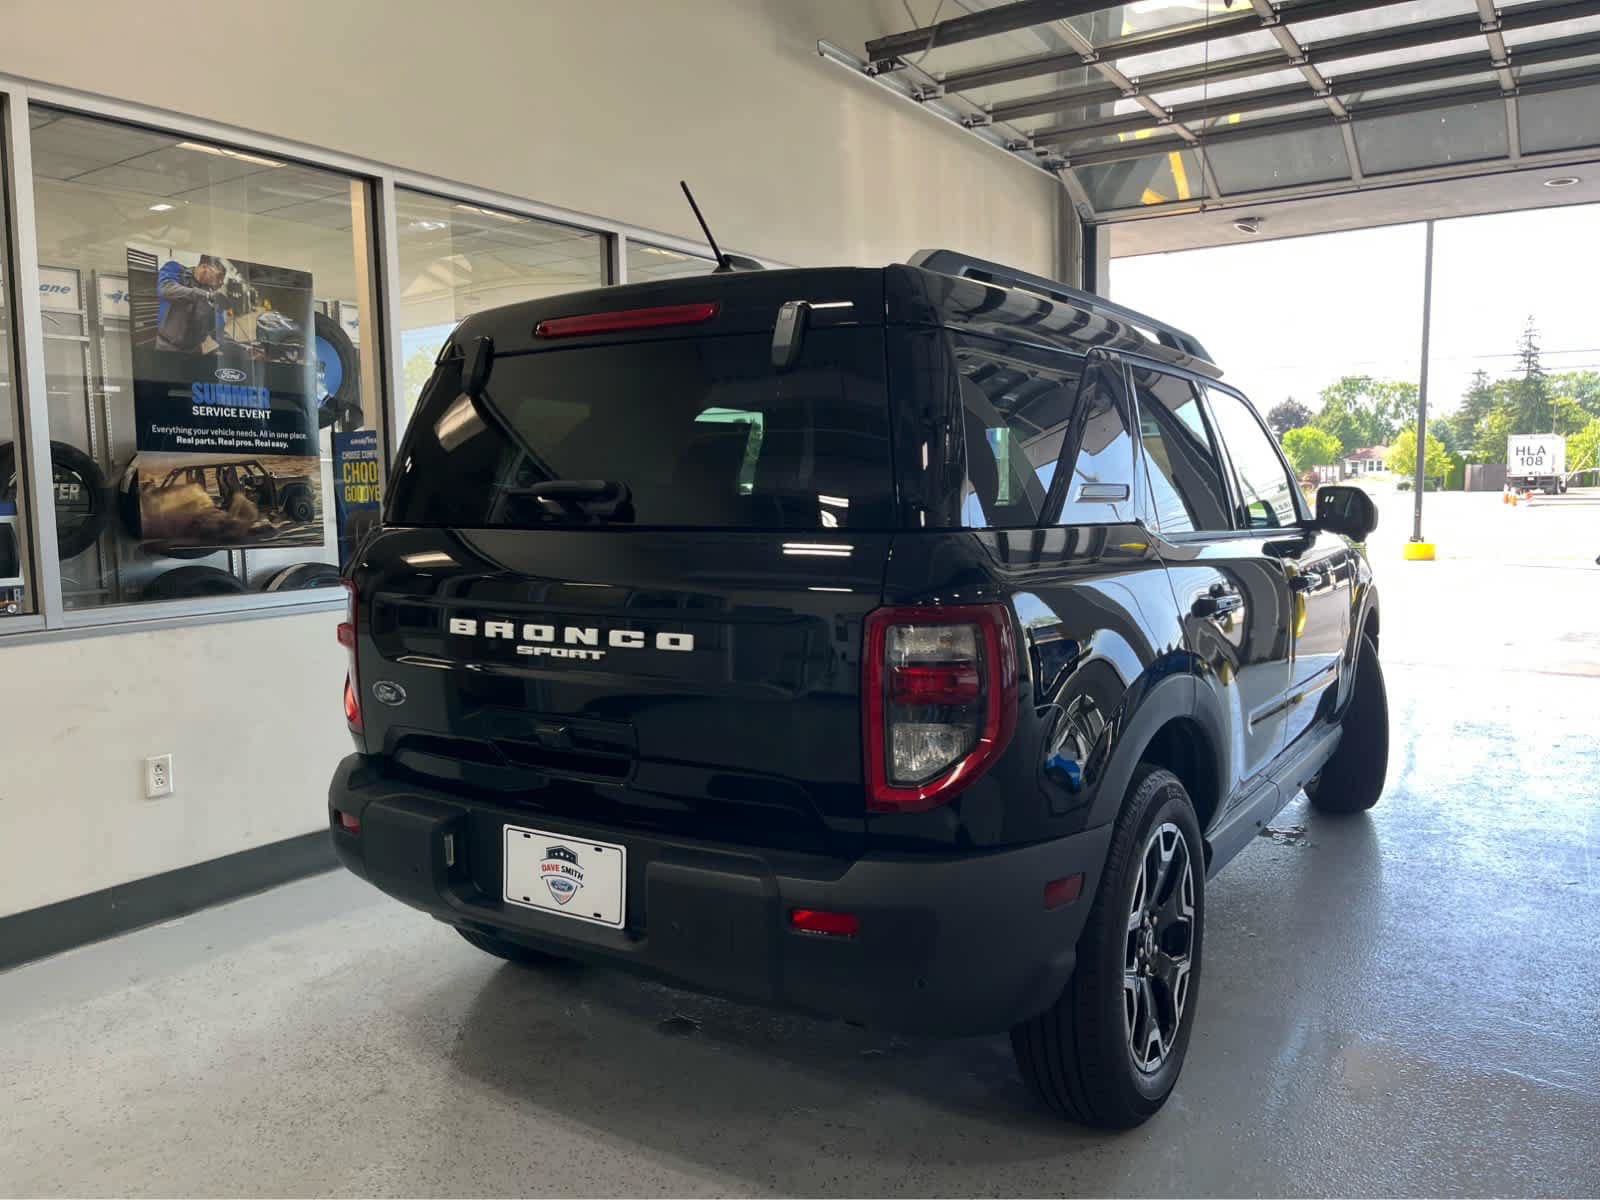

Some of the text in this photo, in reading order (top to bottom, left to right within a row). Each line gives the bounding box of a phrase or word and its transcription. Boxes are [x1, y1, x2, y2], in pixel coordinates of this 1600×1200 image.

[38, 283, 71, 294] ane
[192, 383, 271, 409] SUMMER
[192, 406, 272, 419] SERVICE EVENT
[151, 425, 193, 435] Everything
[193, 428, 209, 436] your
[210, 428, 235, 436] vehicle
[236, 430, 258, 438] needs.
[259, 430, 268, 438] All
[176, 436, 194, 444] Real
[194, 438, 217, 446] parts.
[217, 438, 235, 446] Real
[235, 440, 254, 448] pros.
[254, 439, 271, 447] Real
[1515, 445, 1546, 456] HLA
[1520, 456, 1543, 466] 108
[343, 461, 379, 484] CHOO
[344, 483, 381, 504] GOODYE
[450, 617, 694, 652] BRONCO
[516, 645, 606, 661] SPORT
[541, 864, 584, 881] DAVE SMITH
